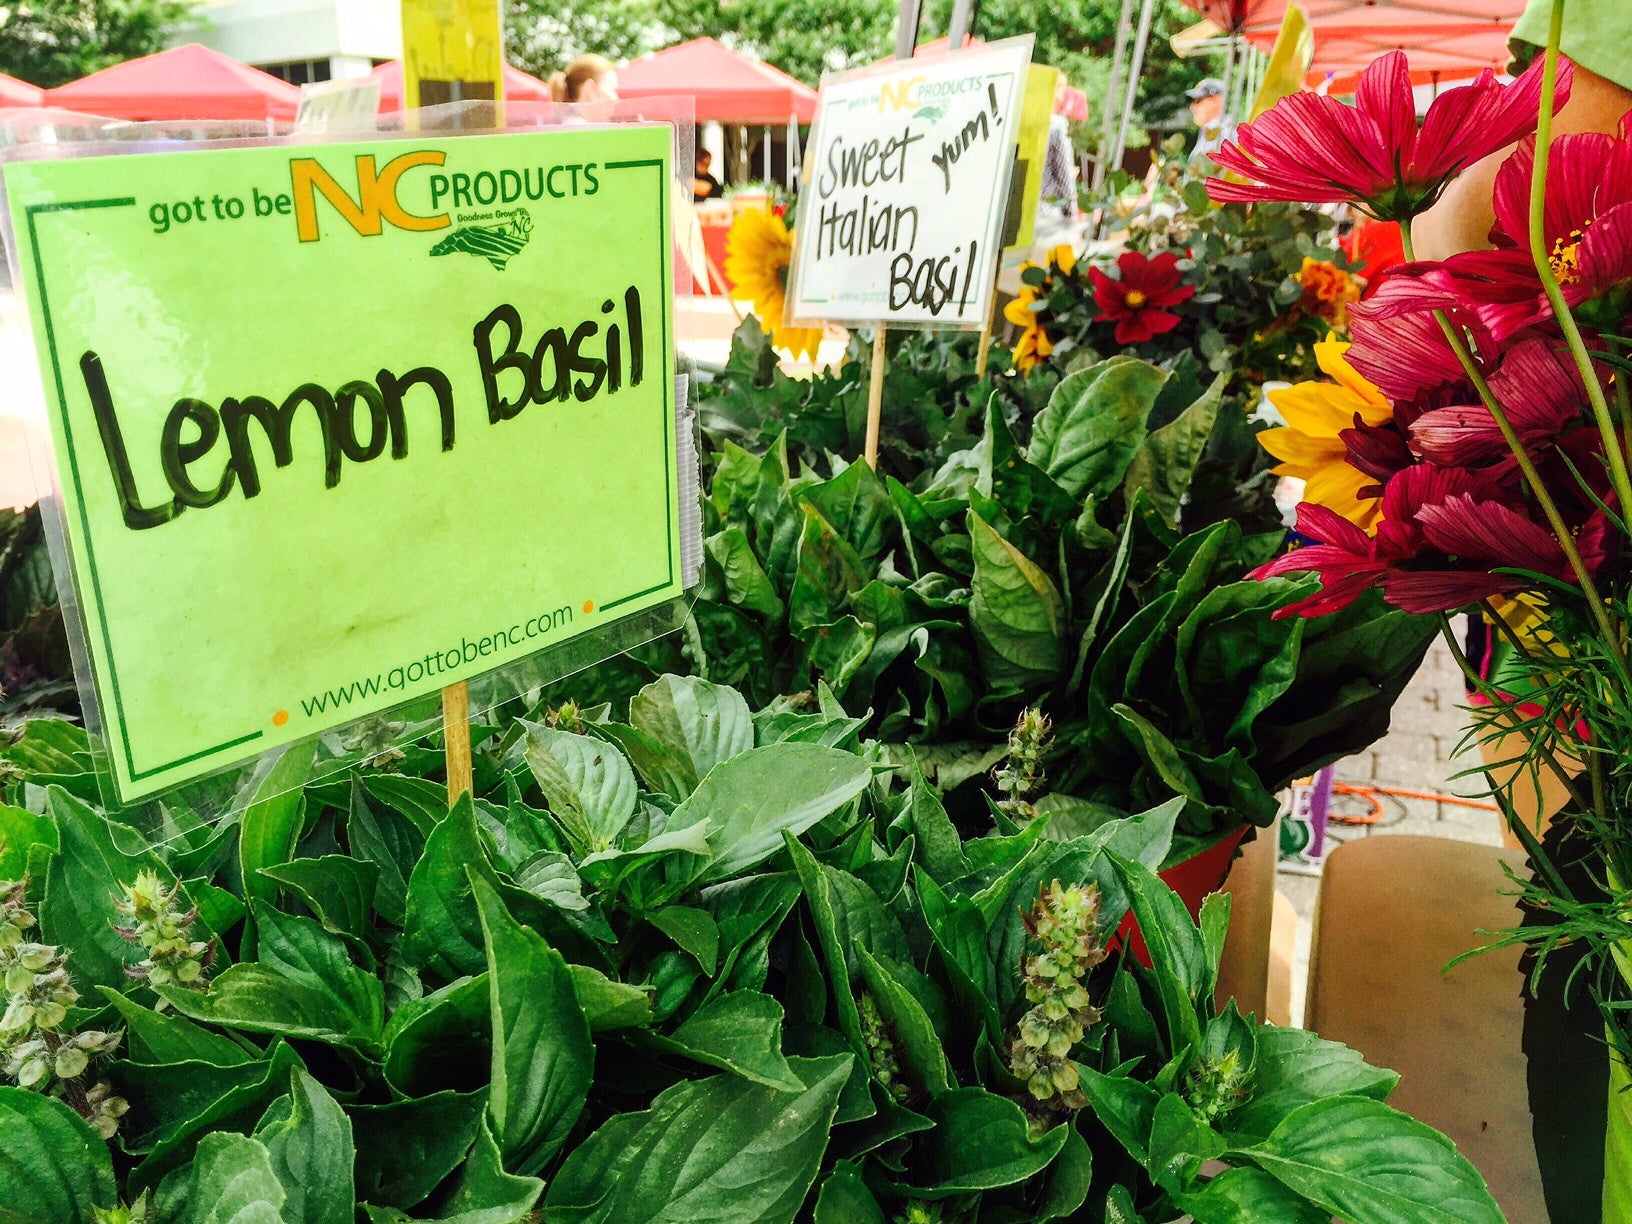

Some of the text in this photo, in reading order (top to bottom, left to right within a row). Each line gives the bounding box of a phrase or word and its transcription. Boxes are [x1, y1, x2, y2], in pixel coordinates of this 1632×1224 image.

[878, 76, 926, 114] NC
[918, 76, 983, 99] PRODUCTS
[150, 150, 600, 243] got to be NC PRODUCTS
[819, 126, 924, 199] Sweet
[457, 212, 494, 223] Goodness
[510, 216, 535, 237] NC
[817, 195, 918, 261] Italian
[889, 240, 978, 318] Basil
[79, 285, 644, 531] Lemon Basil
[300, 603, 575, 718] www.gottobenc.com
